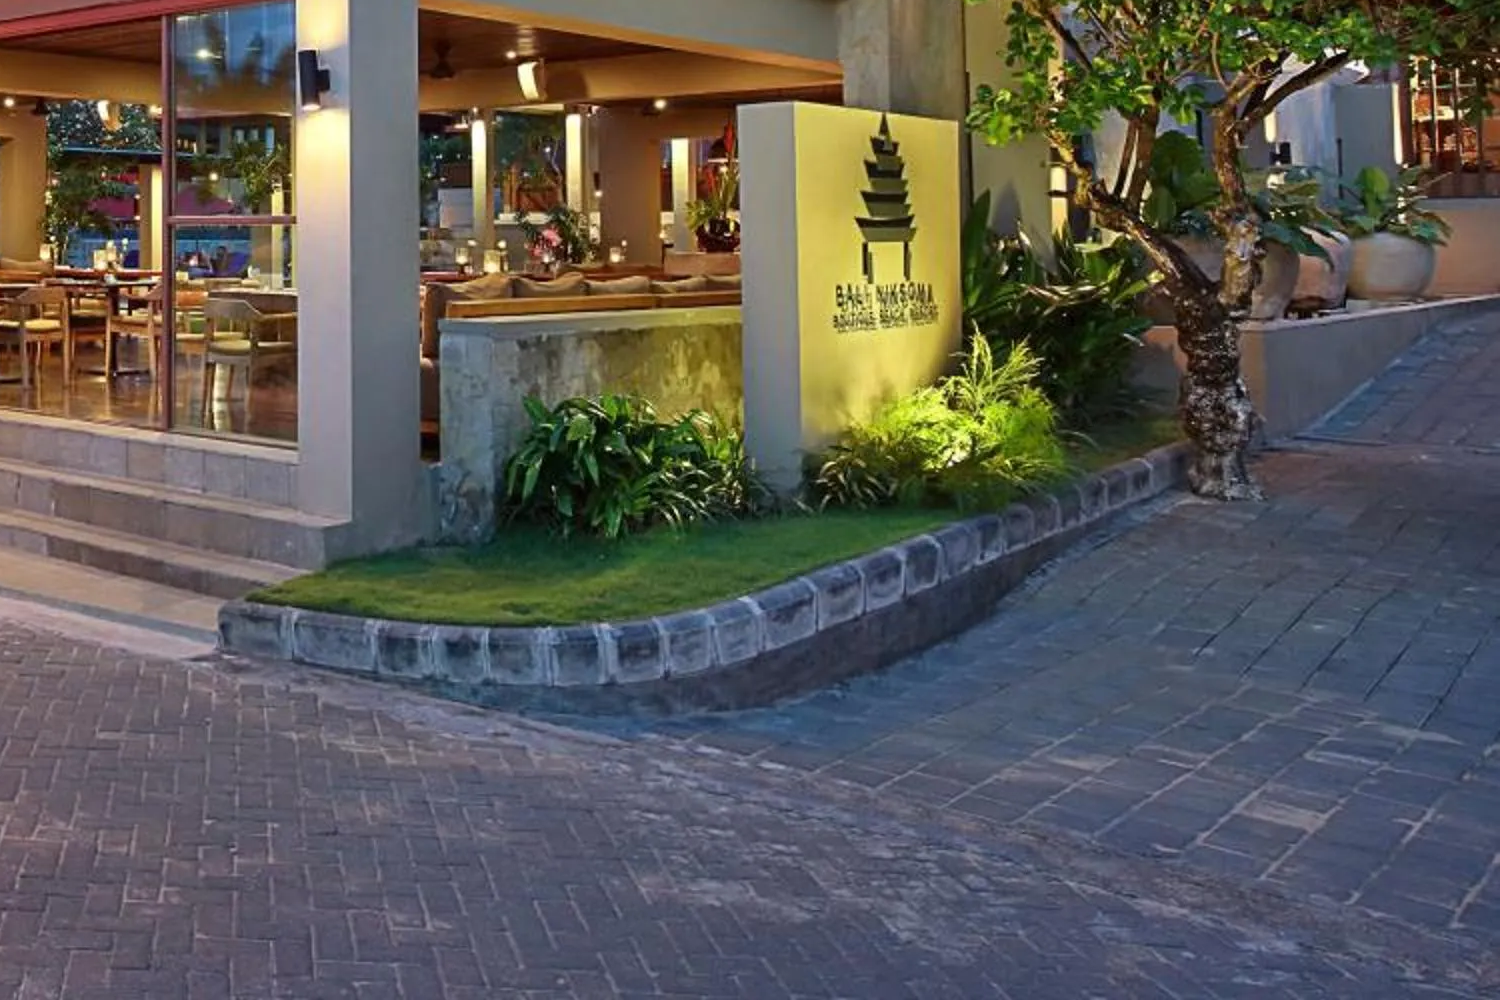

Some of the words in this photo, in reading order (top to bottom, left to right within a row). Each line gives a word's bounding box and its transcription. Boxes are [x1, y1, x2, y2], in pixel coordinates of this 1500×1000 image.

[835, 283, 873, 308] BALI
[875, 282, 935, 305] NIKSOMA
[832, 311, 877, 330] BOUTIQUE
